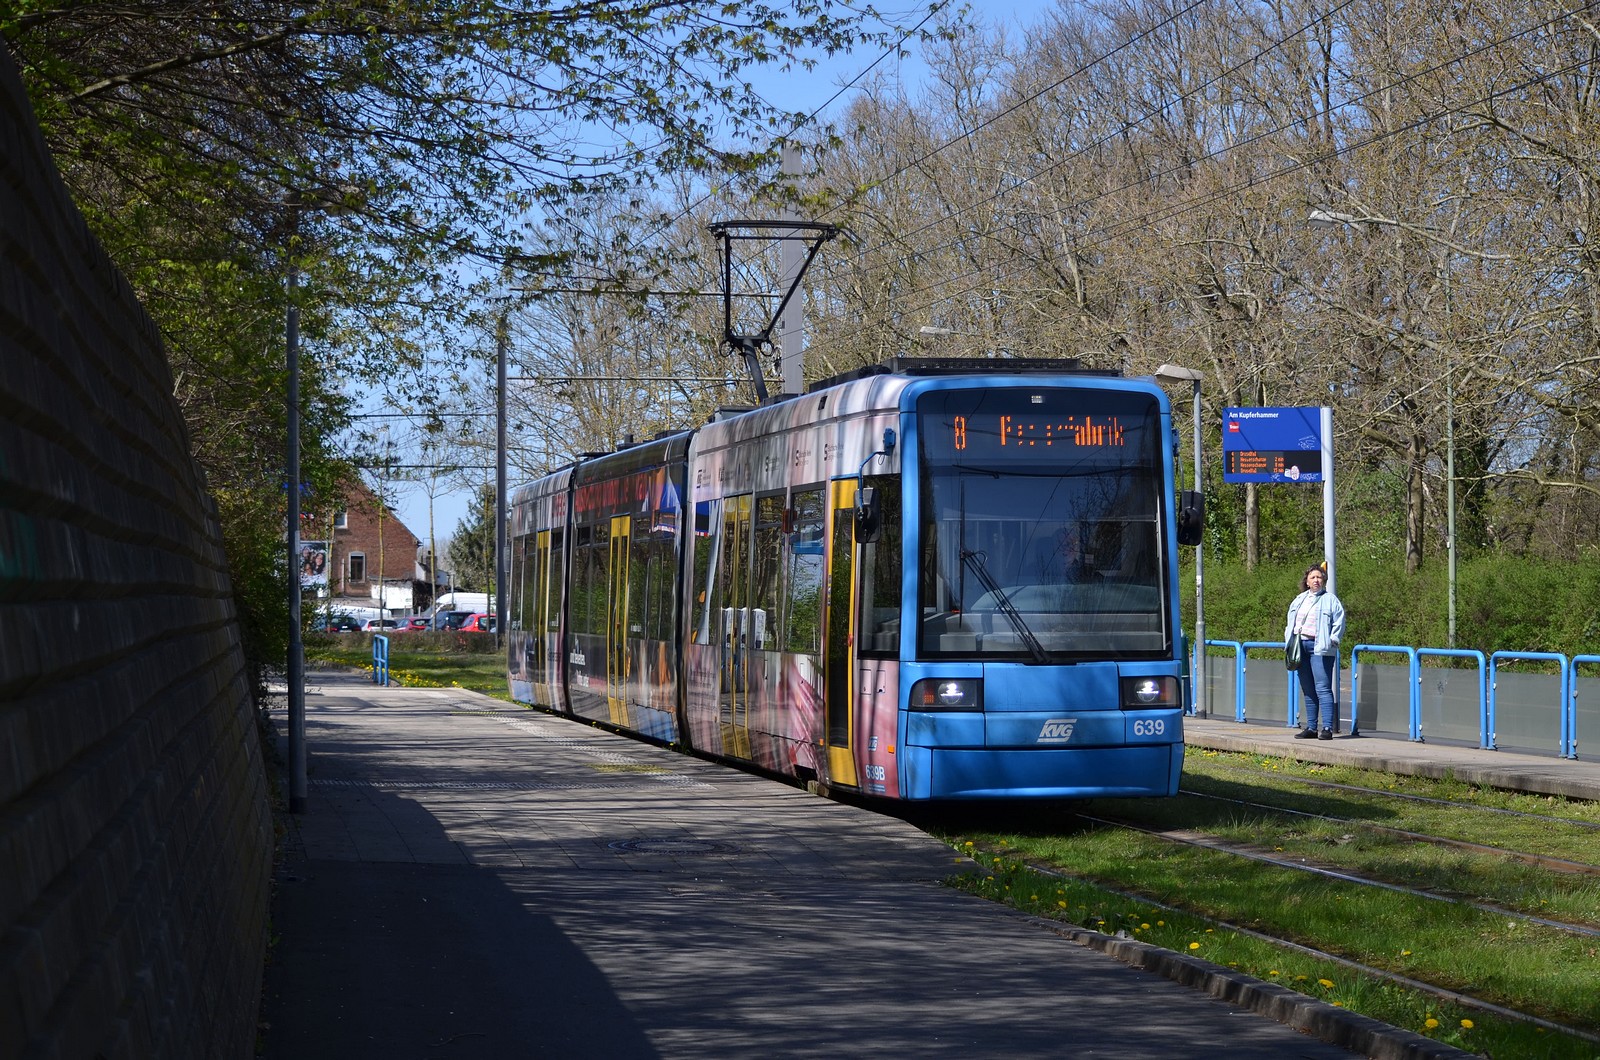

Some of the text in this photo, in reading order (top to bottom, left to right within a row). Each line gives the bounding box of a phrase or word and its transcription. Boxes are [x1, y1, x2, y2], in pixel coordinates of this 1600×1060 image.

[954, 416, 966, 450] 8
[1039, 723, 1074, 738] KVG
[1133, 719, 1165, 736] 639
[865, 764, 885, 781] 639B
